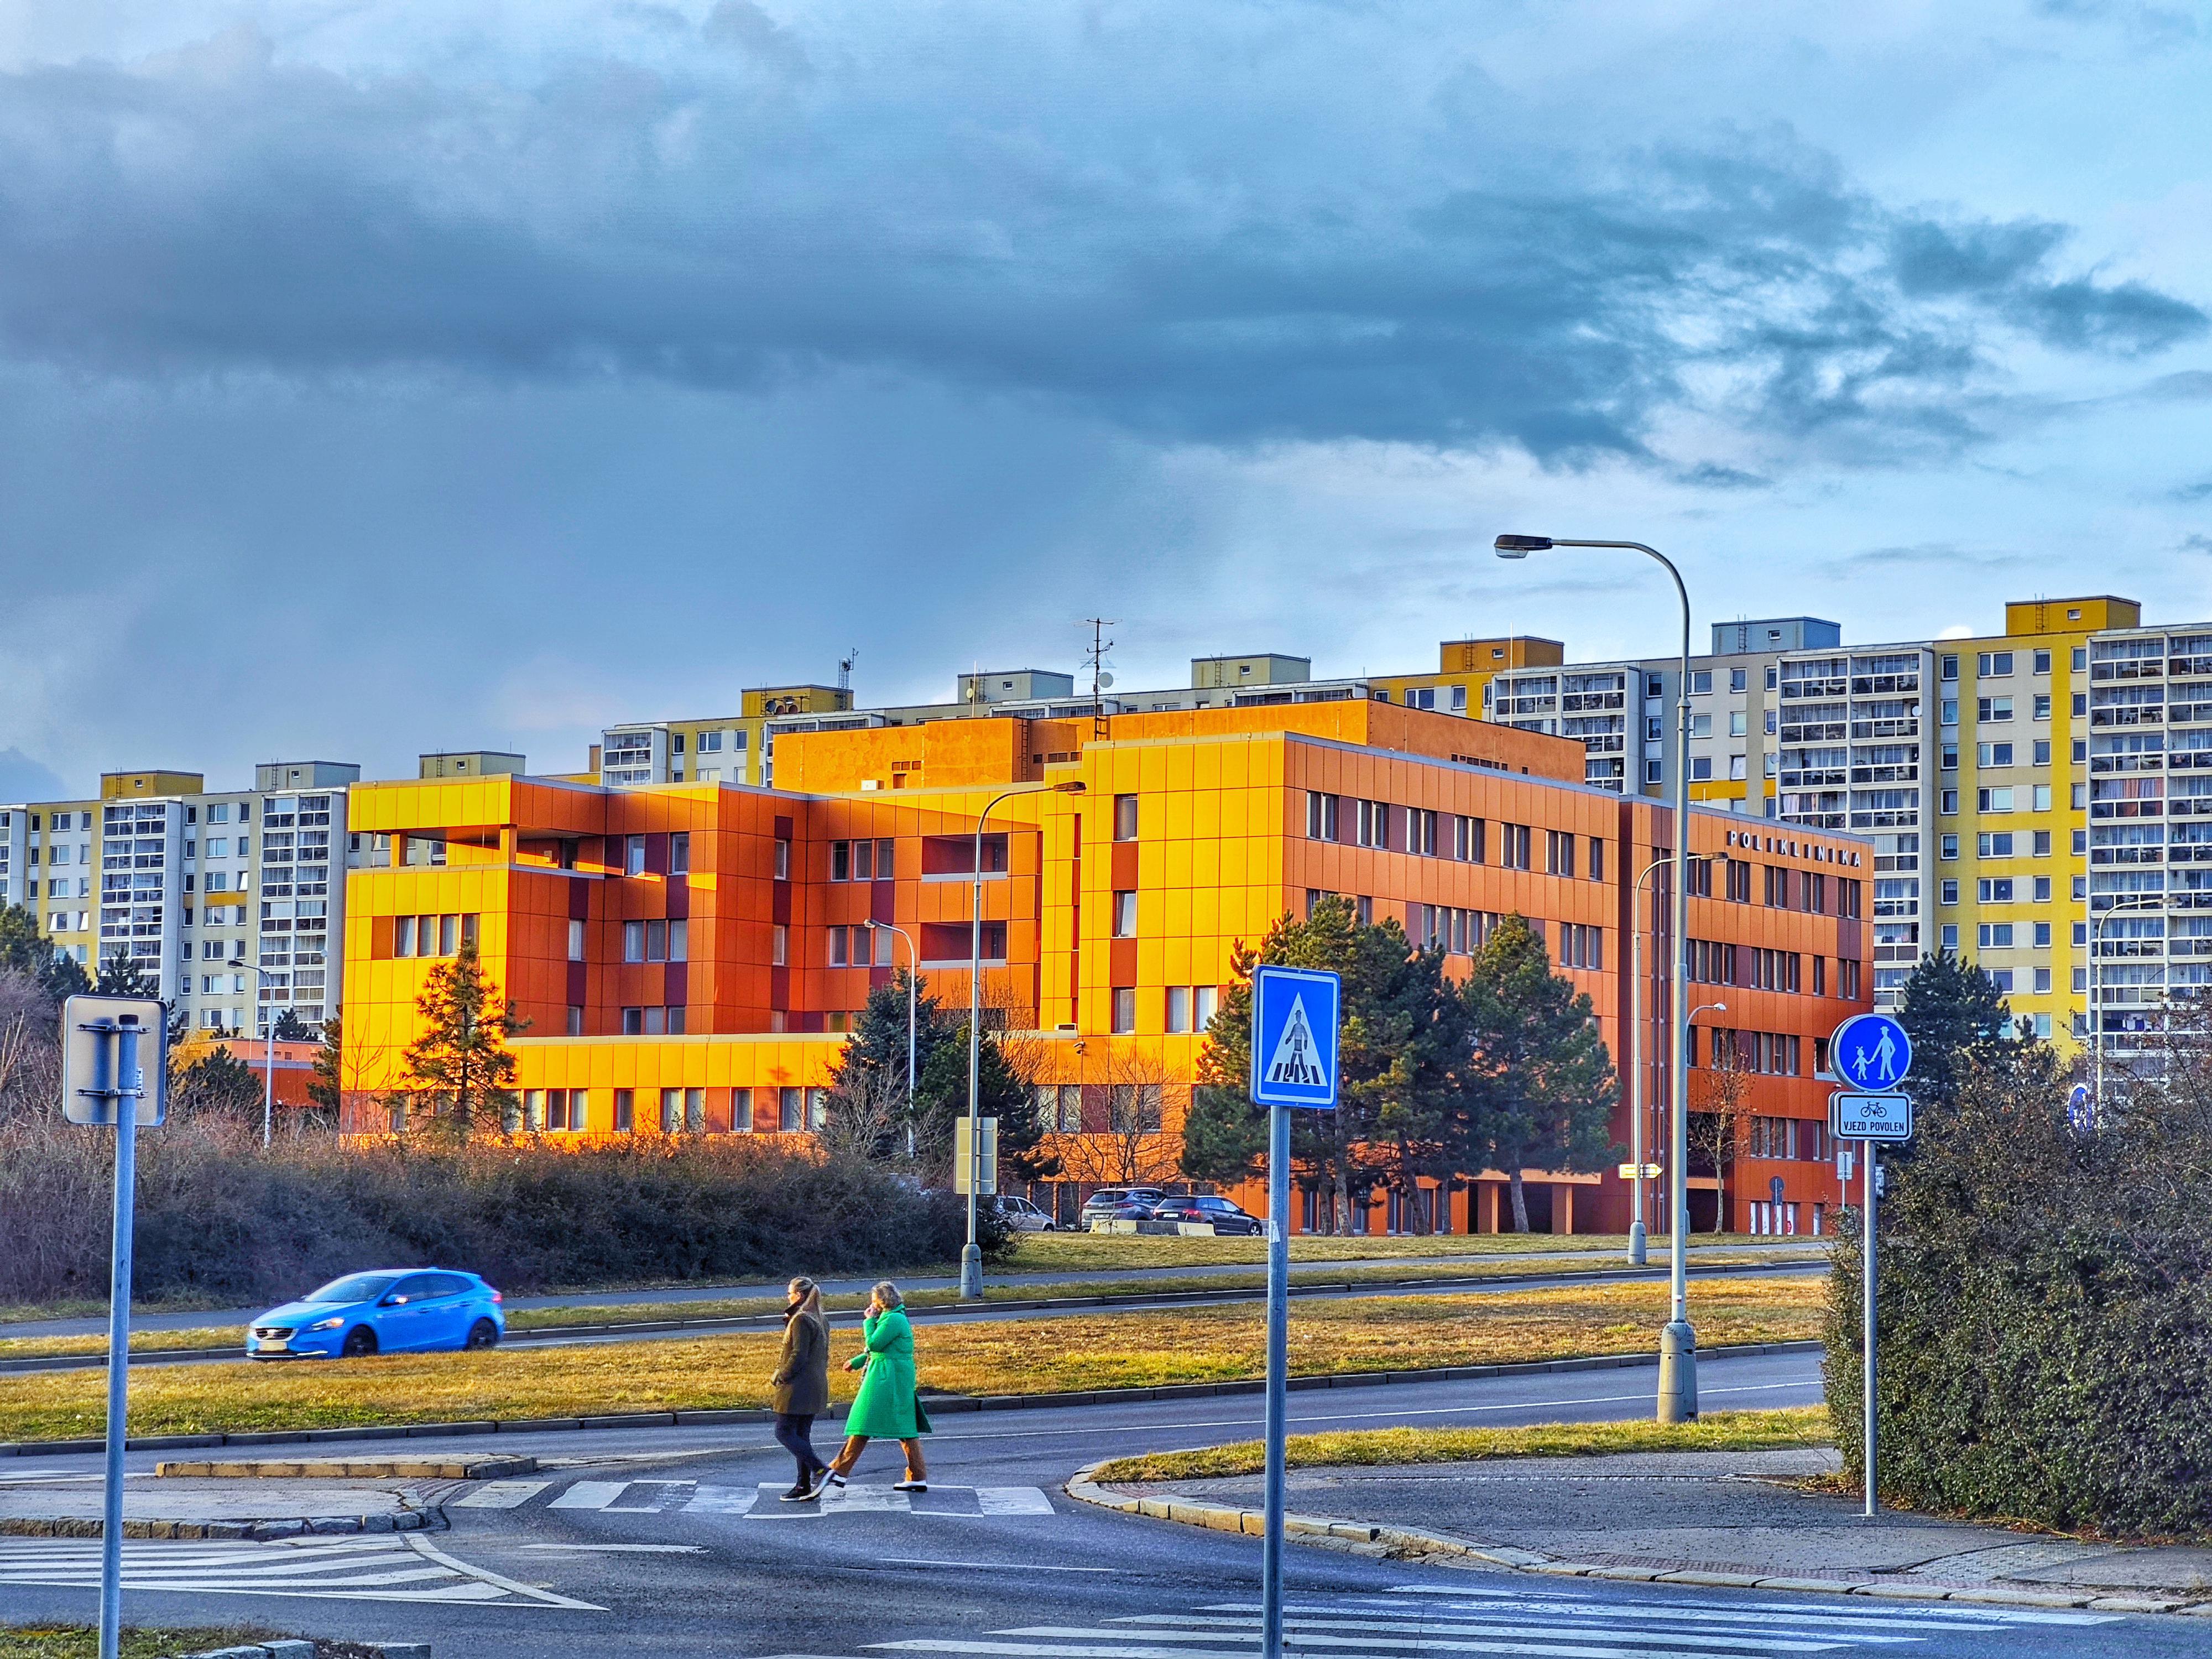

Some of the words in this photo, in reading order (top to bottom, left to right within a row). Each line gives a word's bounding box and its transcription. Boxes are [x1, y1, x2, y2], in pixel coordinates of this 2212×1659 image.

[1728, 831, 1861, 867] POLIKLINIKA
[1844, 1121, 1866, 1131] VJEZD
[1870, 1121, 1904, 1131] POVOLEN
